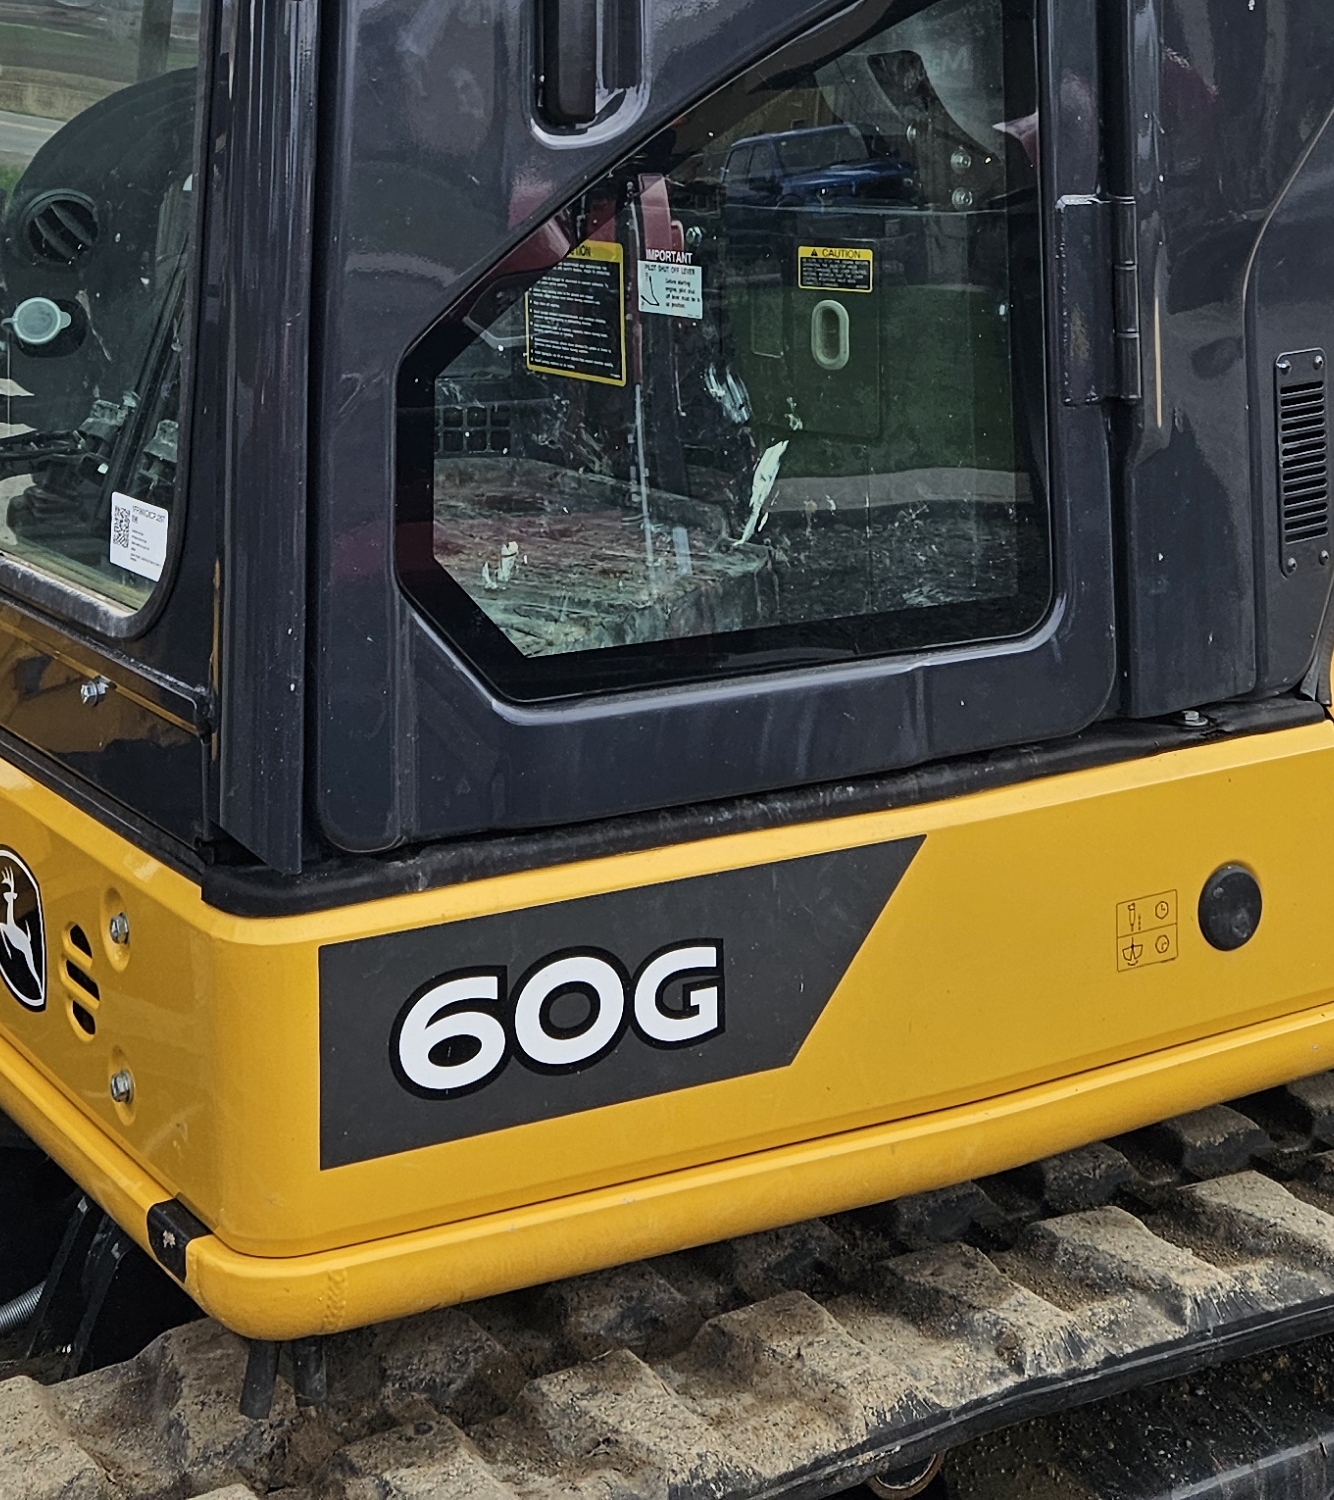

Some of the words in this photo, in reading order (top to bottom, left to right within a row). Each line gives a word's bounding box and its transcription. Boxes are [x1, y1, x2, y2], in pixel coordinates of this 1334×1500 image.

[646, 248, 693, 264] IMPORTANT
[822, 248, 861, 259] CAUTION
[397, 945, 719, 1092] 60G
